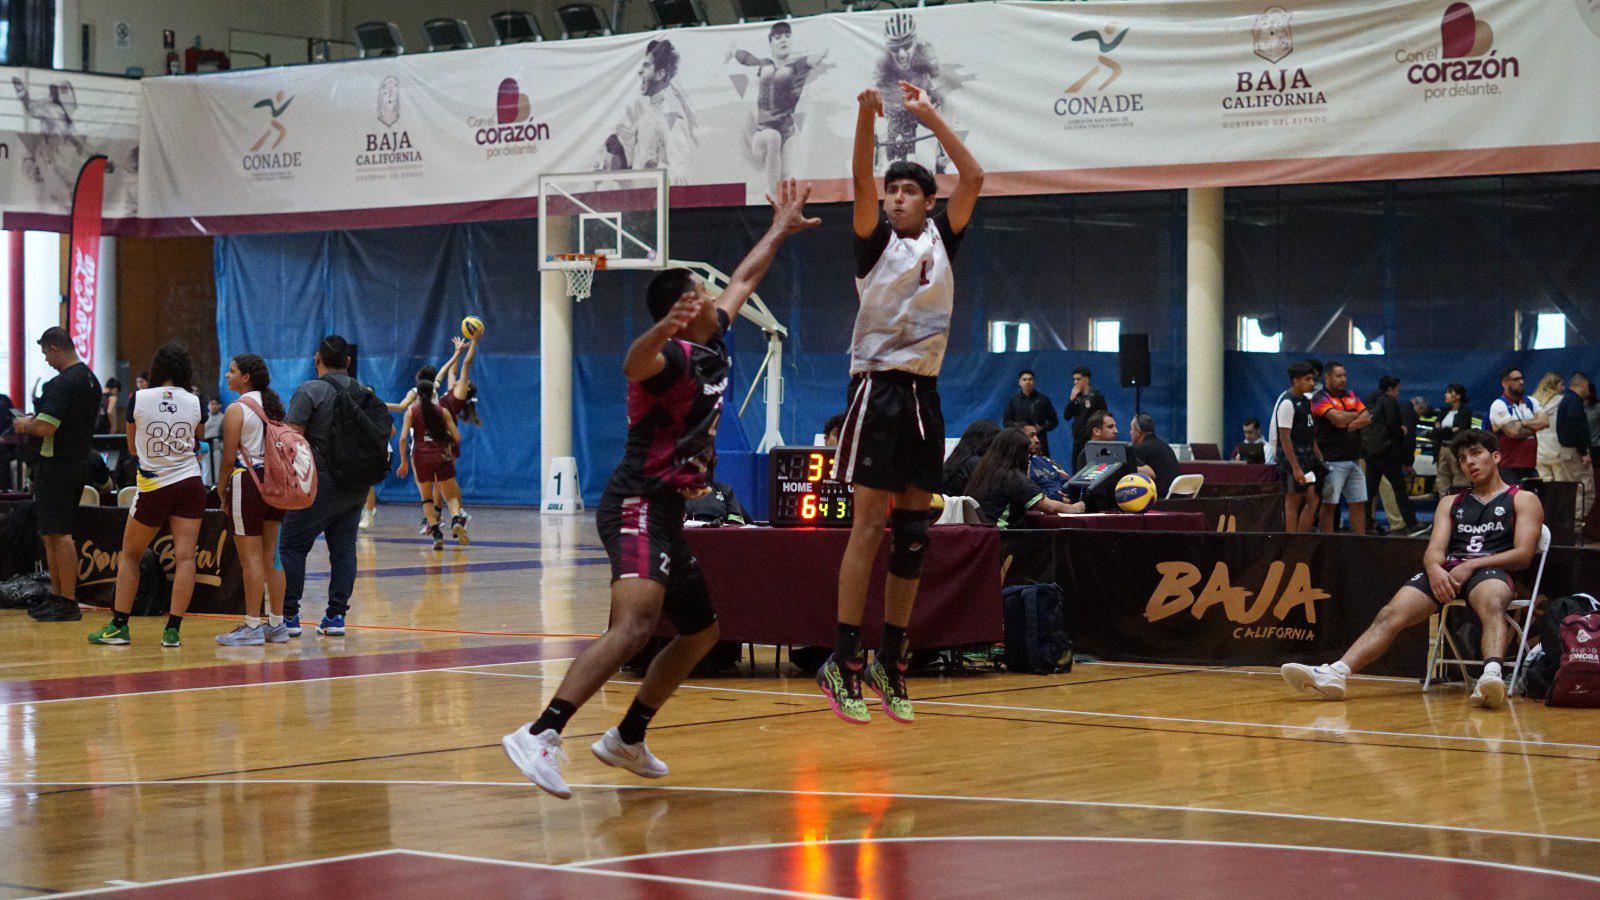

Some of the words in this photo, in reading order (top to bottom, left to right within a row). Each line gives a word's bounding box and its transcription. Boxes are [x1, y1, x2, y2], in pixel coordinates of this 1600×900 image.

[1395, 49, 1424, 63] Con
[1426, 46, 1438, 60] el
[1407, 50, 1519, 84] corazón
[1236, 68, 1312, 93] BAJA
[1222, 91, 1327, 110] CALIFORNIA
[1424, 87, 1446, 102] por
[1448, 82, 1502, 97] delante.
[1053, 93, 1144, 116] CONADE
[475, 116, 550, 145] corazón
[366, 131, 412, 152] BAJA
[243, 152, 302, 171] CONADE
[356, 151, 423, 166] CALIFORNIA
[919, 260, 930, 286] 1
[554, 472, 562, 496] 1
[782, 482, 813, 493] HOME
[801, 494, 817, 519] 6
[818, 503, 829, 517] 4
[836, 501, 846, 519] 3
[1457, 521, 1505, 534] SONORA
[1142, 560, 1333, 625] BAJA
[1232, 626, 1316, 641] CALIFORNIA
